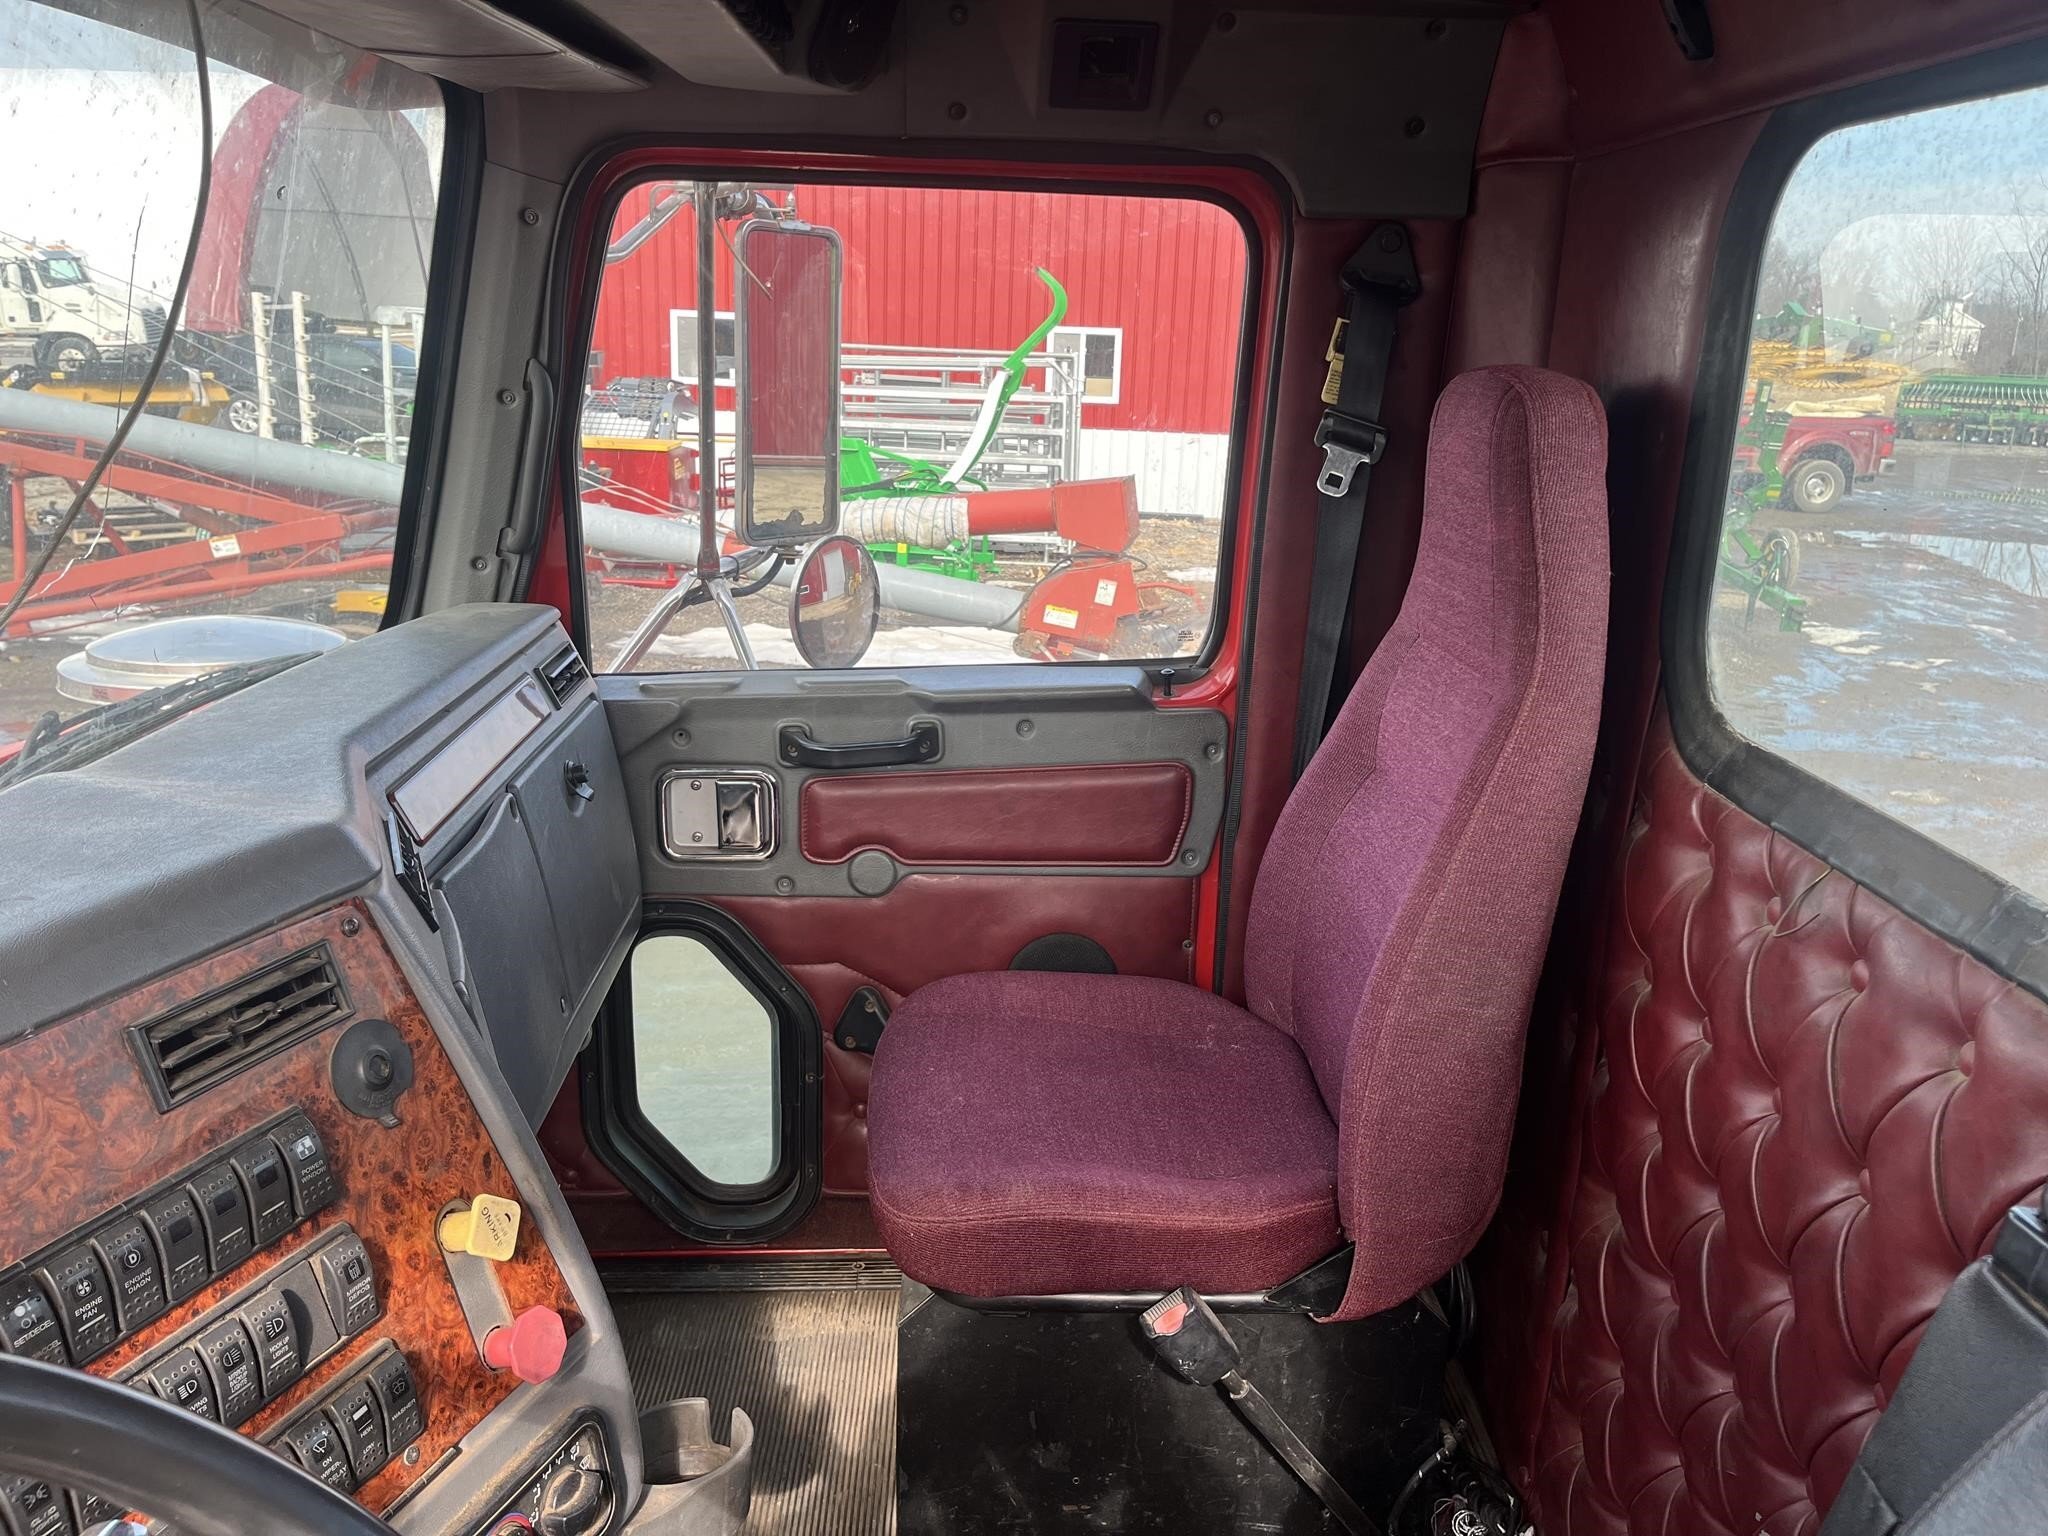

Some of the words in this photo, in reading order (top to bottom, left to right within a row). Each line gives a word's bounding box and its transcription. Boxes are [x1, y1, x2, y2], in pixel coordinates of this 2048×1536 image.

[301, 1159, 324, 1175] POWER
[301, 1163, 328, 1184] WINDOW
[124, 1266, 152, 1289] ENGINE
[128, 1276, 151, 1295] DIAGN
[346, 1276, 371, 1298] MIRROR
[348, 1284, 370, 1302] DEFOG
[74, 1295, 104, 1318] ENGINE
[82, 1307, 98, 1321] FAN
[13, 1319, 55, 1349] SET/DECEL
[272, 1344, 289, 1360] LIGHTS
[391, 1398, 416, 1421] WASHER
[360, 1424, 374, 1439] HIGH
[362, 1440, 375, 1455] LOW
[322, 1456, 333, 1468] ON
[327, 1464, 347, 1485] DELAY
